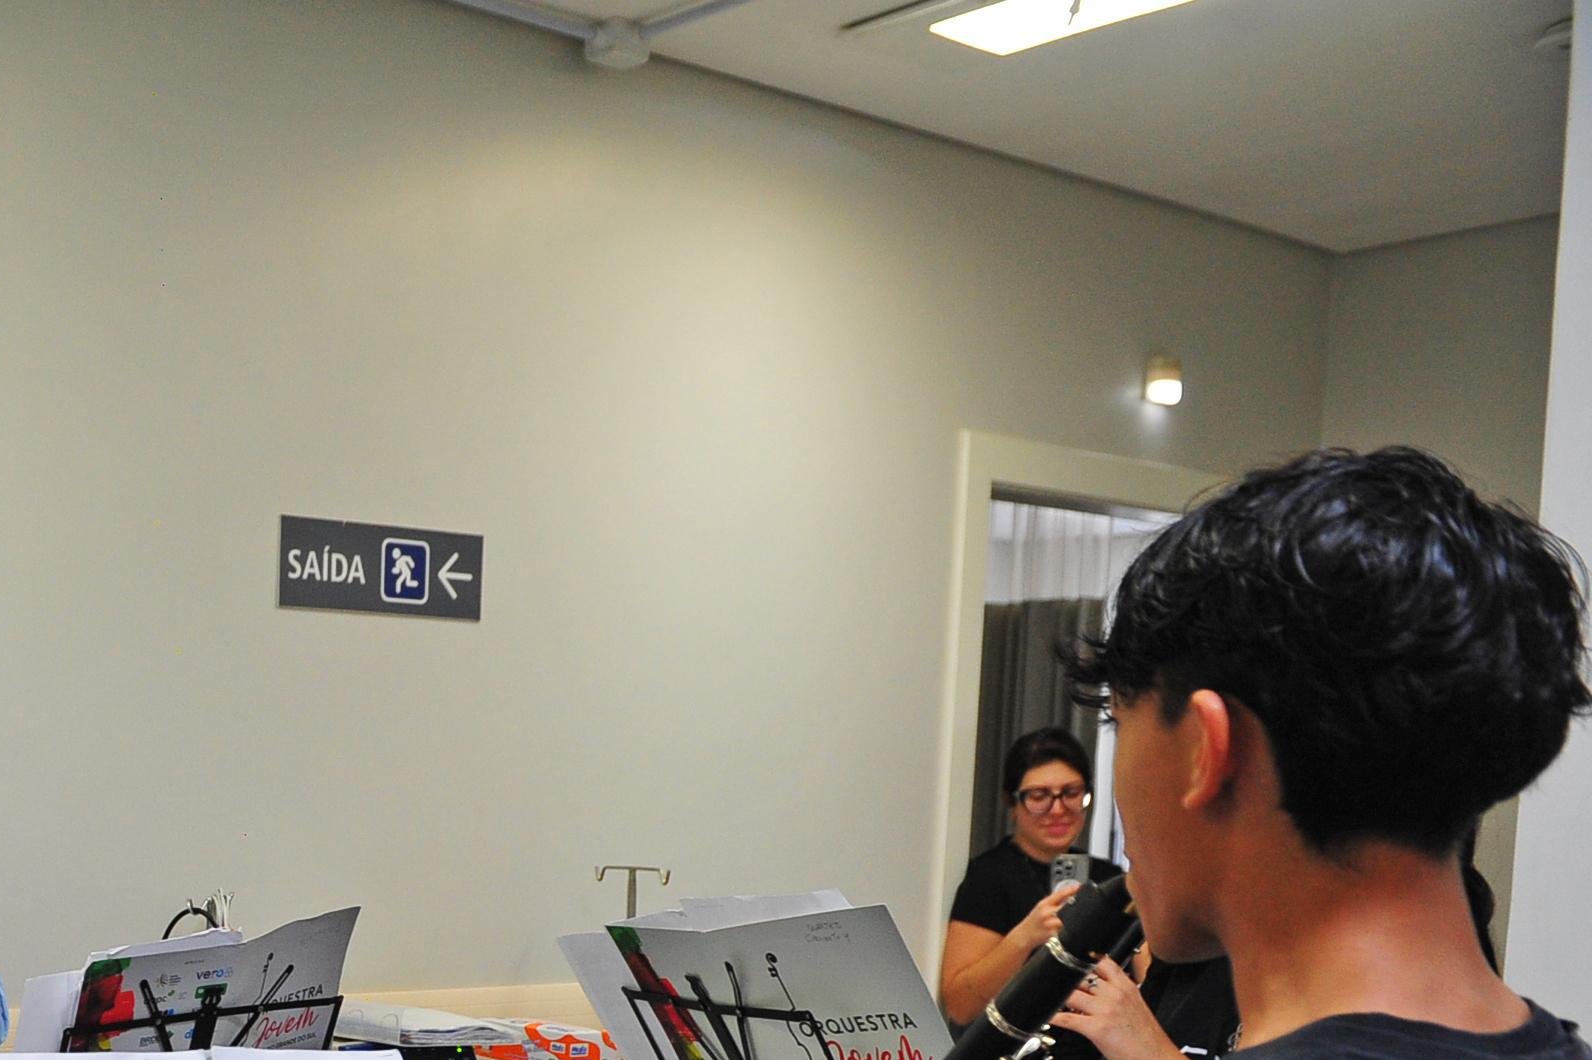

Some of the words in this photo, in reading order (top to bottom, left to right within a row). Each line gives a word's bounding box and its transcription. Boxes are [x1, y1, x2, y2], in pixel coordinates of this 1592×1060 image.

[287, 546, 366, 585] SAÍDA
[251, 1006, 319, 1049] Jovem
[798, 1012, 918, 1038] ORQUESTRA
